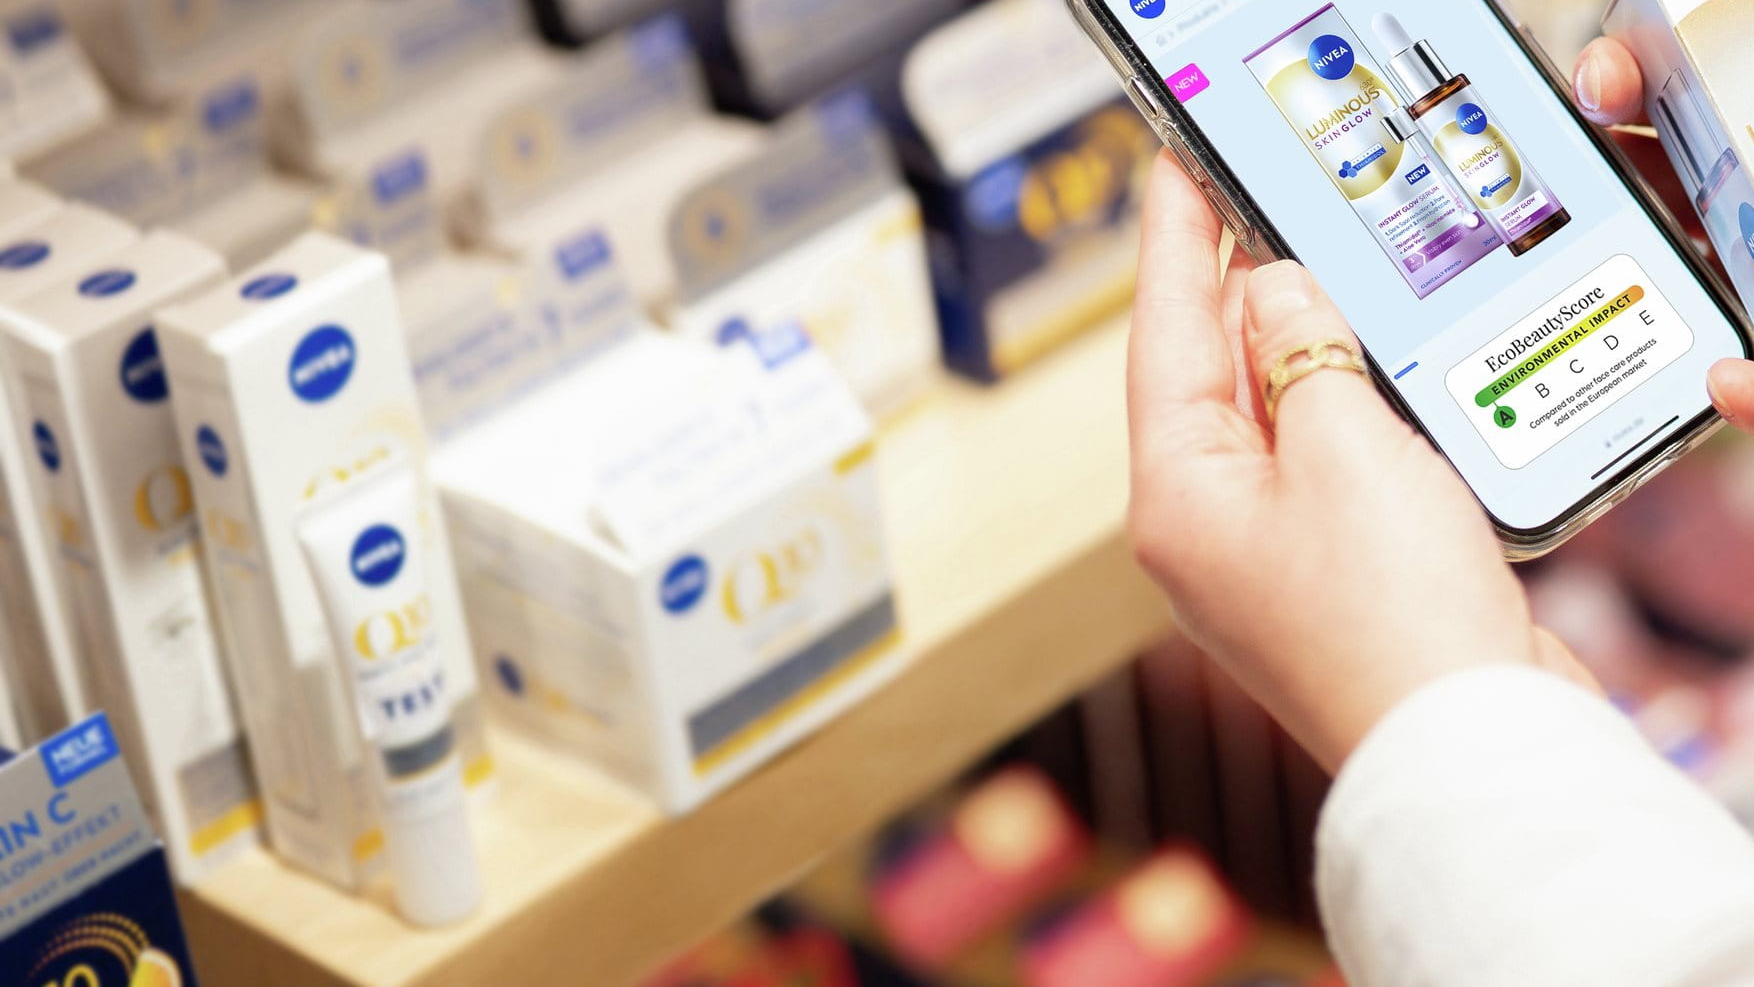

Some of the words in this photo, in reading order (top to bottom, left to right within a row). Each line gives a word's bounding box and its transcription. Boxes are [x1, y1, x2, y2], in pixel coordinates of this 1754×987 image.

[1313, 45, 1349, 71] NIVEA
[1174, 72, 1199, 93] NEW
[1305, 88, 1380, 141] LUMINOUS
[1460, 111, 1483, 129] NIVEA
[1406, 166, 1428, 184] NEW
[1459, 140, 1504, 172] LUMINOUS
[1378, 208, 1403, 229] INSTANT
[1402, 199, 1420, 213] GLOW
[1418, 186, 1440, 203] SERUM
[1500, 205, 1522, 223] INSTANT
[1520, 196, 1536, 210] GLOW
[1504, 213, 1523, 228] SERUM
[1420, 271, 1445, 290] CLINICALLY
[1443, 259, 1462, 274] PROVEN
[1484, 287, 1605, 374] EcoBeautyScore
[1492, 325, 1589, 396] ENVIRONMENTAL
[1588, 294, 1632, 327] IMPACT
[295, 346, 350, 385] NIVEA
[1500, 410, 1514, 426] A
[1534, 382, 1550, 398] B
[1569, 358, 1584, 374] C
[1603, 335, 1619, 350] D
[1639, 309, 1655, 326] E
[1529, 400, 1568, 429] Compared
[1565, 394, 1576, 404] to
[1574, 380, 1595, 398] other
[1592, 371, 1611, 387] face
[1609, 360, 1626, 374] care
[1624, 338, 1657, 367] products
[1553, 412, 1571, 428] sold
[1575, 399, 1589, 413] the
[1587, 377, 1623, 404] European
[1620, 358, 1648, 382] market
[356, 539, 402, 572] NIVEA
[381, 668, 444, 721] TEST
[51, 724, 105, 764] NEUE
[0, 809, 42, 860] IN
[46, 791, 76, 826] C
